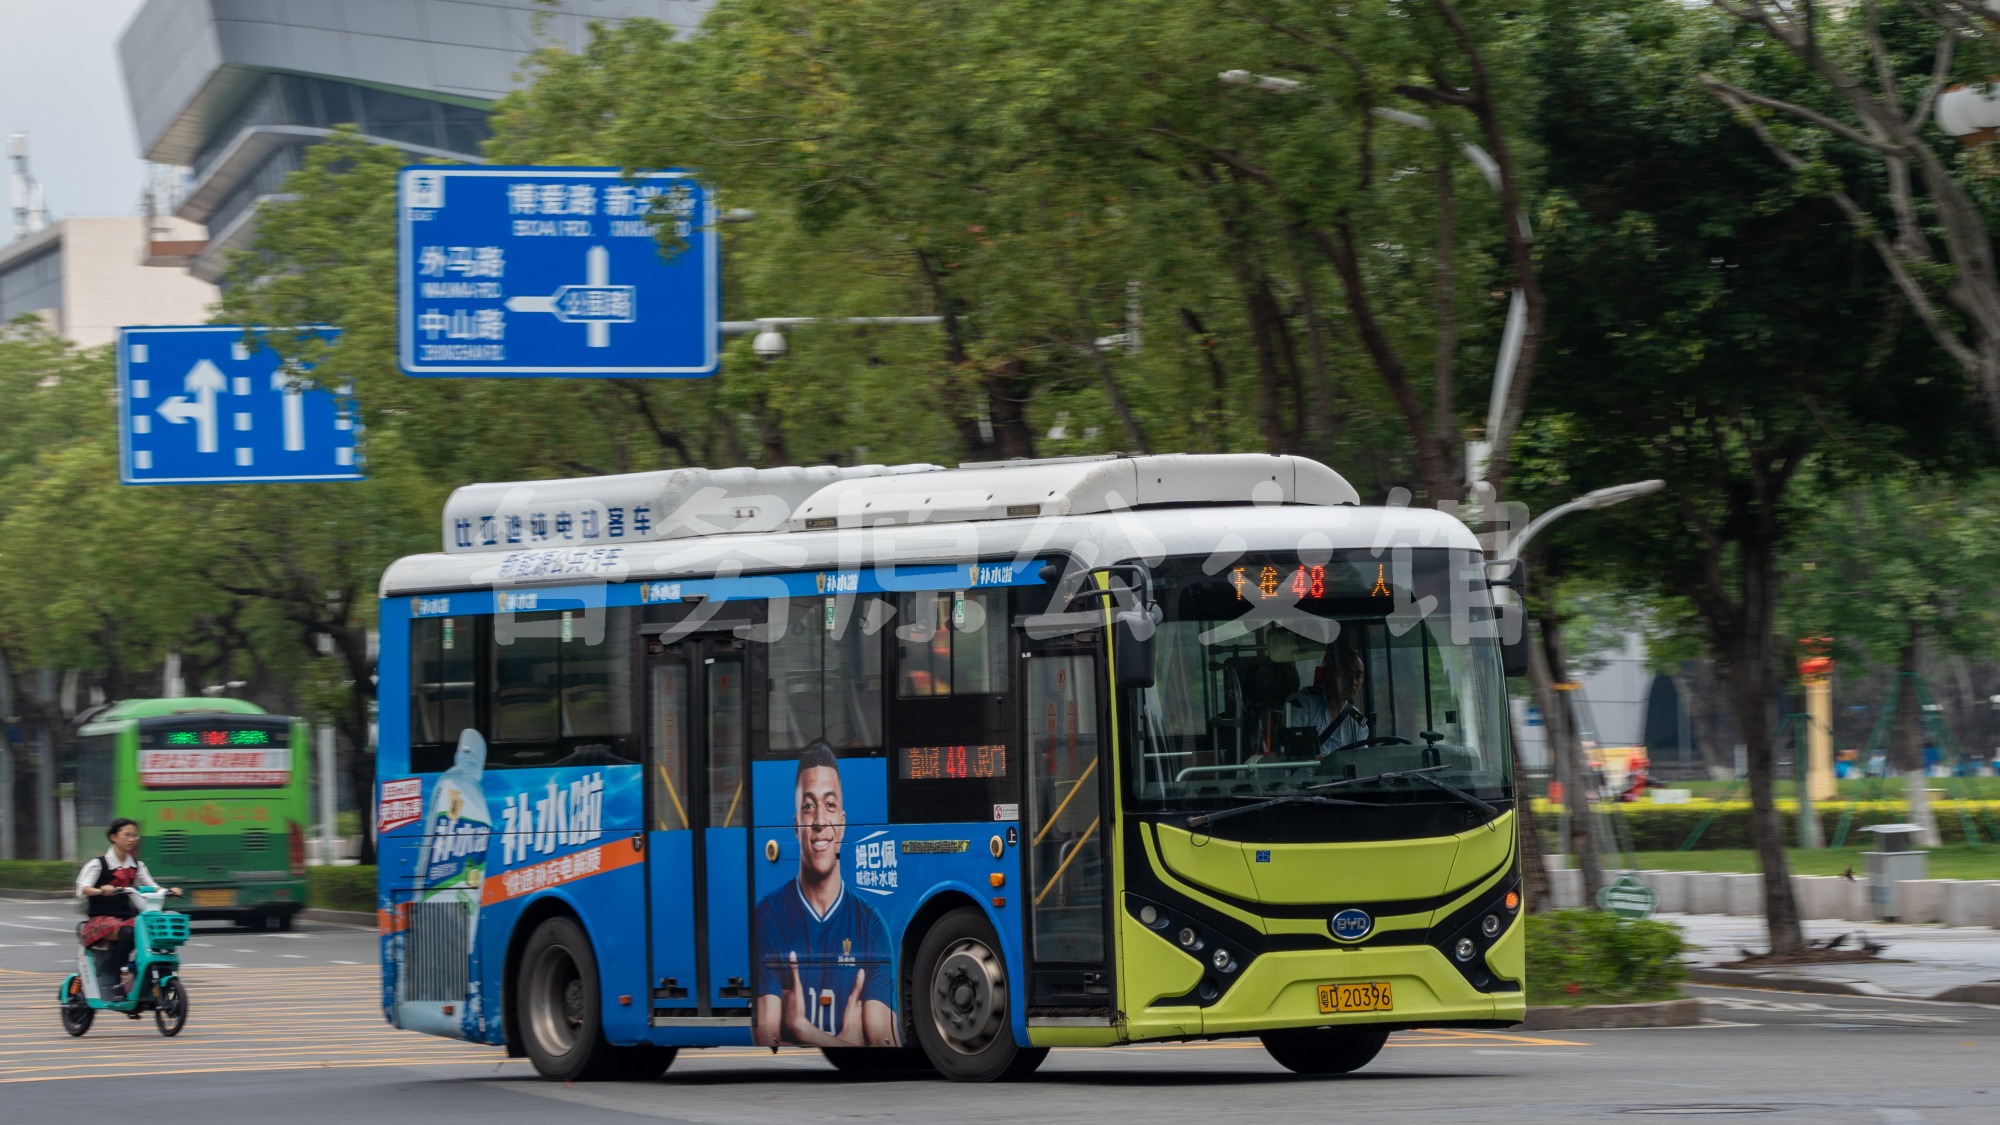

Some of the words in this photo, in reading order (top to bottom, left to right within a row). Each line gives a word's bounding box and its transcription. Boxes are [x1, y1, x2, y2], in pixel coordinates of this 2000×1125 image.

[507, 183, 598, 215] 博爱路
[418, 246, 506, 277] 外马路
[418, 308, 506, 340] 中山路
[454, 505, 651, 548] 比亚迪纯电动客车
[498, 547, 624, 578] 新能源公共汽车
[980, 566, 1013, 584] 补水啦
[826, 574, 859, 592] 补水啦
[1292, 565, 1325, 598] 48
[946, 745, 967, 779] 48
[501, 771, 604, 866] 补水啦
[431, 818, 490, 864] 补水啦
[1008, 829, 1017, 843] 上
[855, 840, 897, 870] 姆巴佩
[506, 847, 602, 896] 快速补充电解质
[856, 870, 898, 887] 喊你补水啦
[1337, 917, 1367, 931] BYD
[808, 987, 836, 1037] 10
